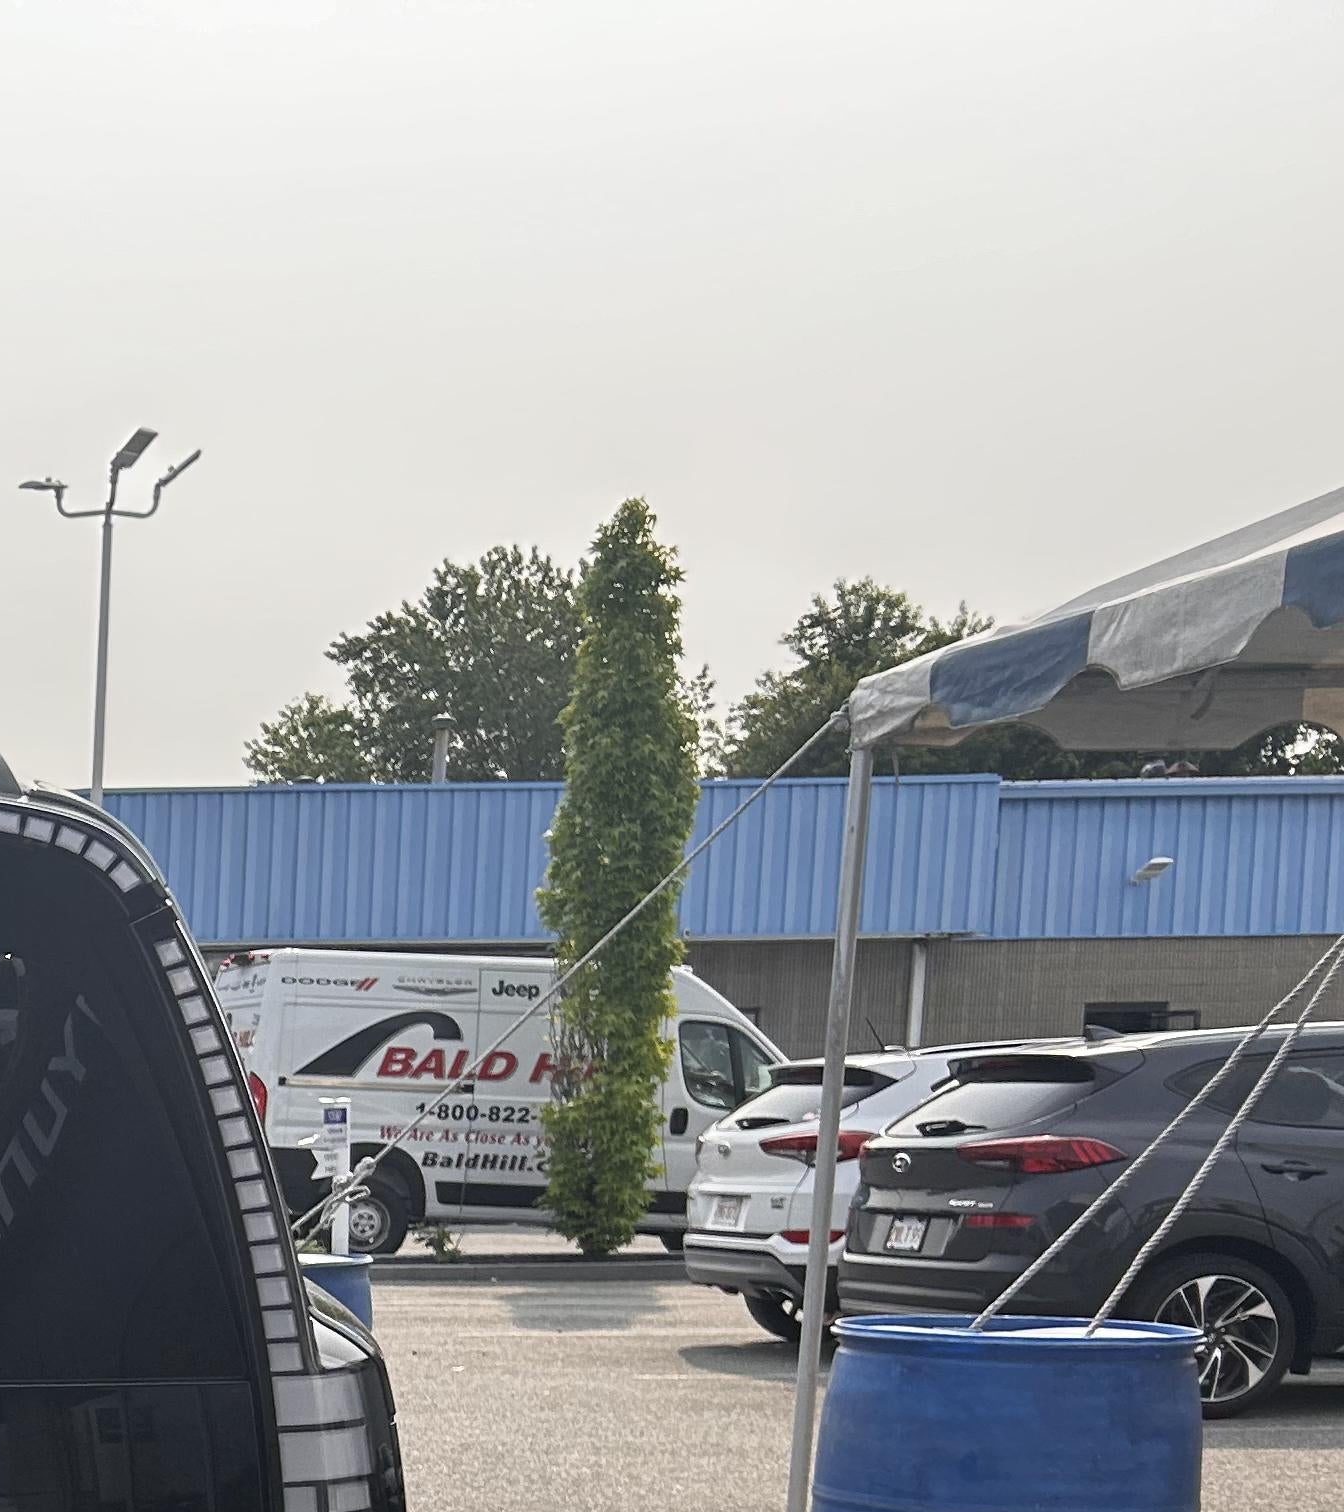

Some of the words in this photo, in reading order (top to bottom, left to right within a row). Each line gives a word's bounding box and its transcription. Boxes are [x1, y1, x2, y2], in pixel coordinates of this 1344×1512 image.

[492, 981, 540, 1000] Jeep
[377, 1046, 519, 1082] BALD
[407, 1127, 434, 1142] Are
[440, 1129, 459, 1143] As
[465, 1129, 506, 1145] Close
